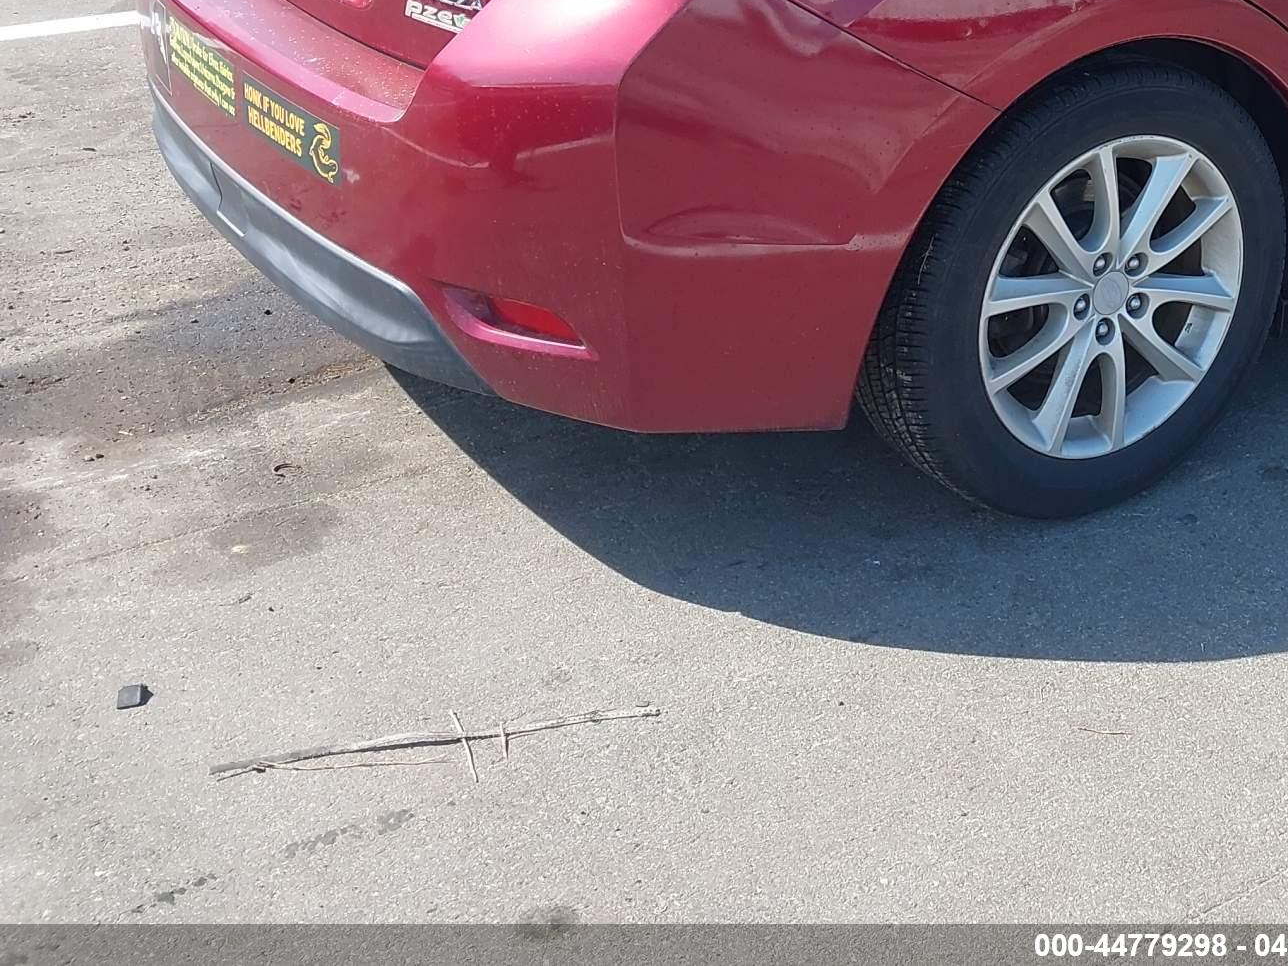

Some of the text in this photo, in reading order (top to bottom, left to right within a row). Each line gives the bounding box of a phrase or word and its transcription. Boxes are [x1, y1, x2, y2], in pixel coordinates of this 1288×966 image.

[244, 82, 305, 137] HONK IF YOU LOVE
[247, 105, 303, 157] HELLBENDERS
